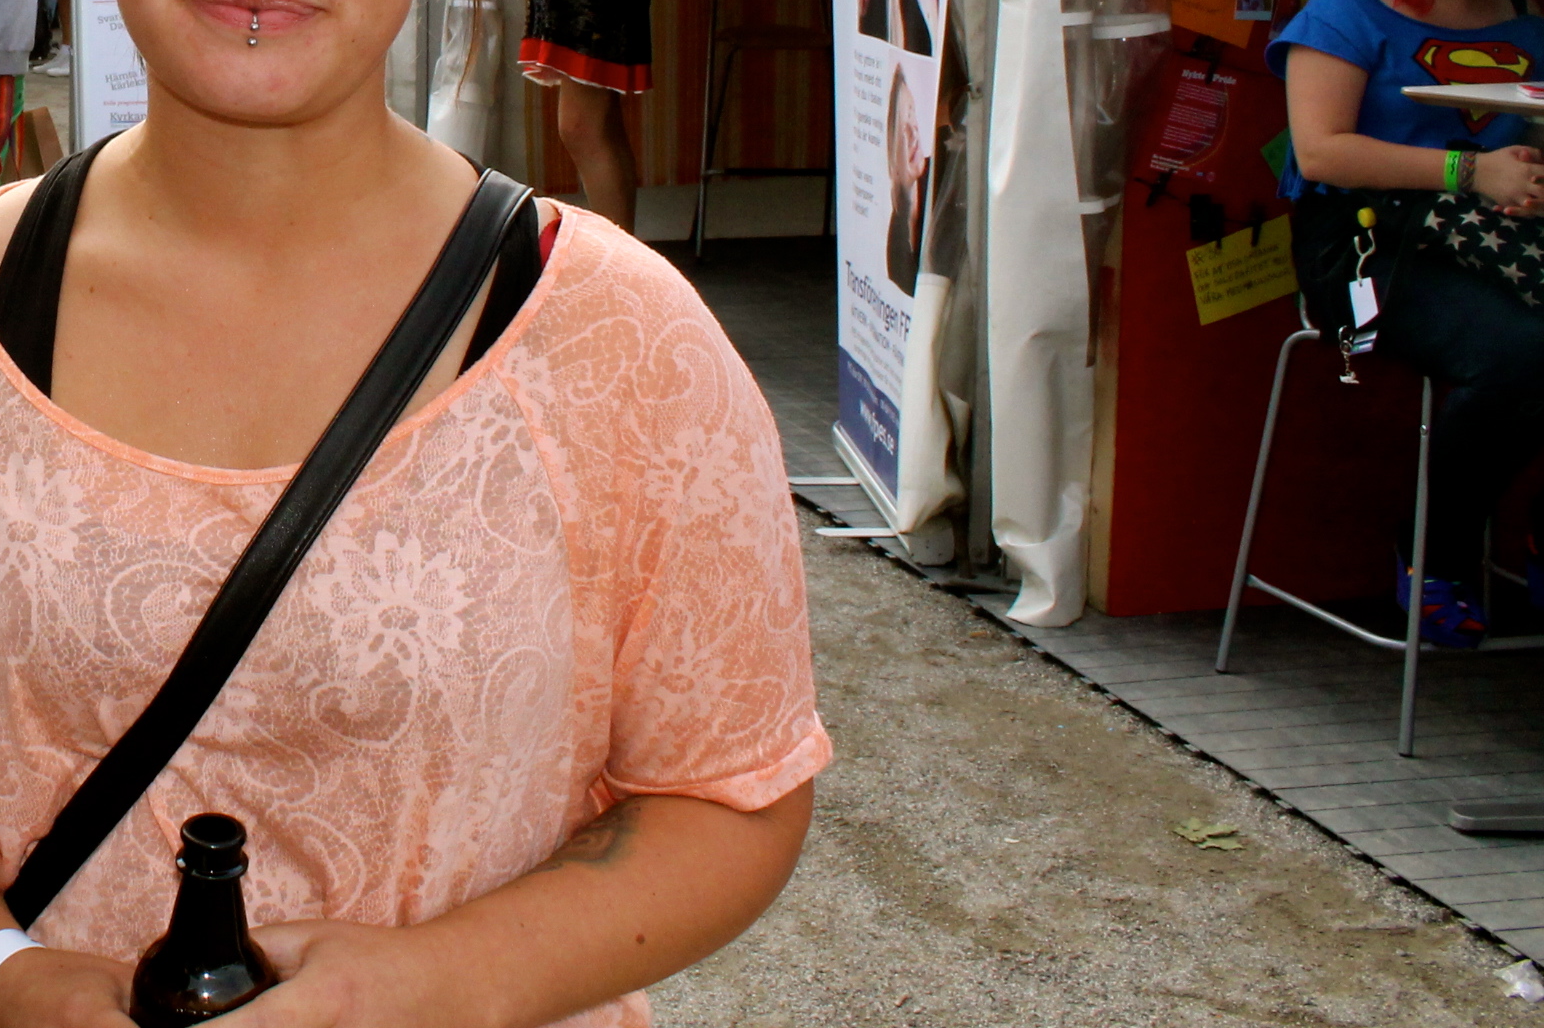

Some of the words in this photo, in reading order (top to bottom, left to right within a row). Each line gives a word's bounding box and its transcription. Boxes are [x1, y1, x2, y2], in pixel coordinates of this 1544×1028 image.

[97, 14, 121, 24] Svar
[109, 22, 124, 31] Da
[105, 71, 137, 83] Hämta
[1181, 69, 1208, 80] Nykte
[1211, 73, 1238, 85] Pride
